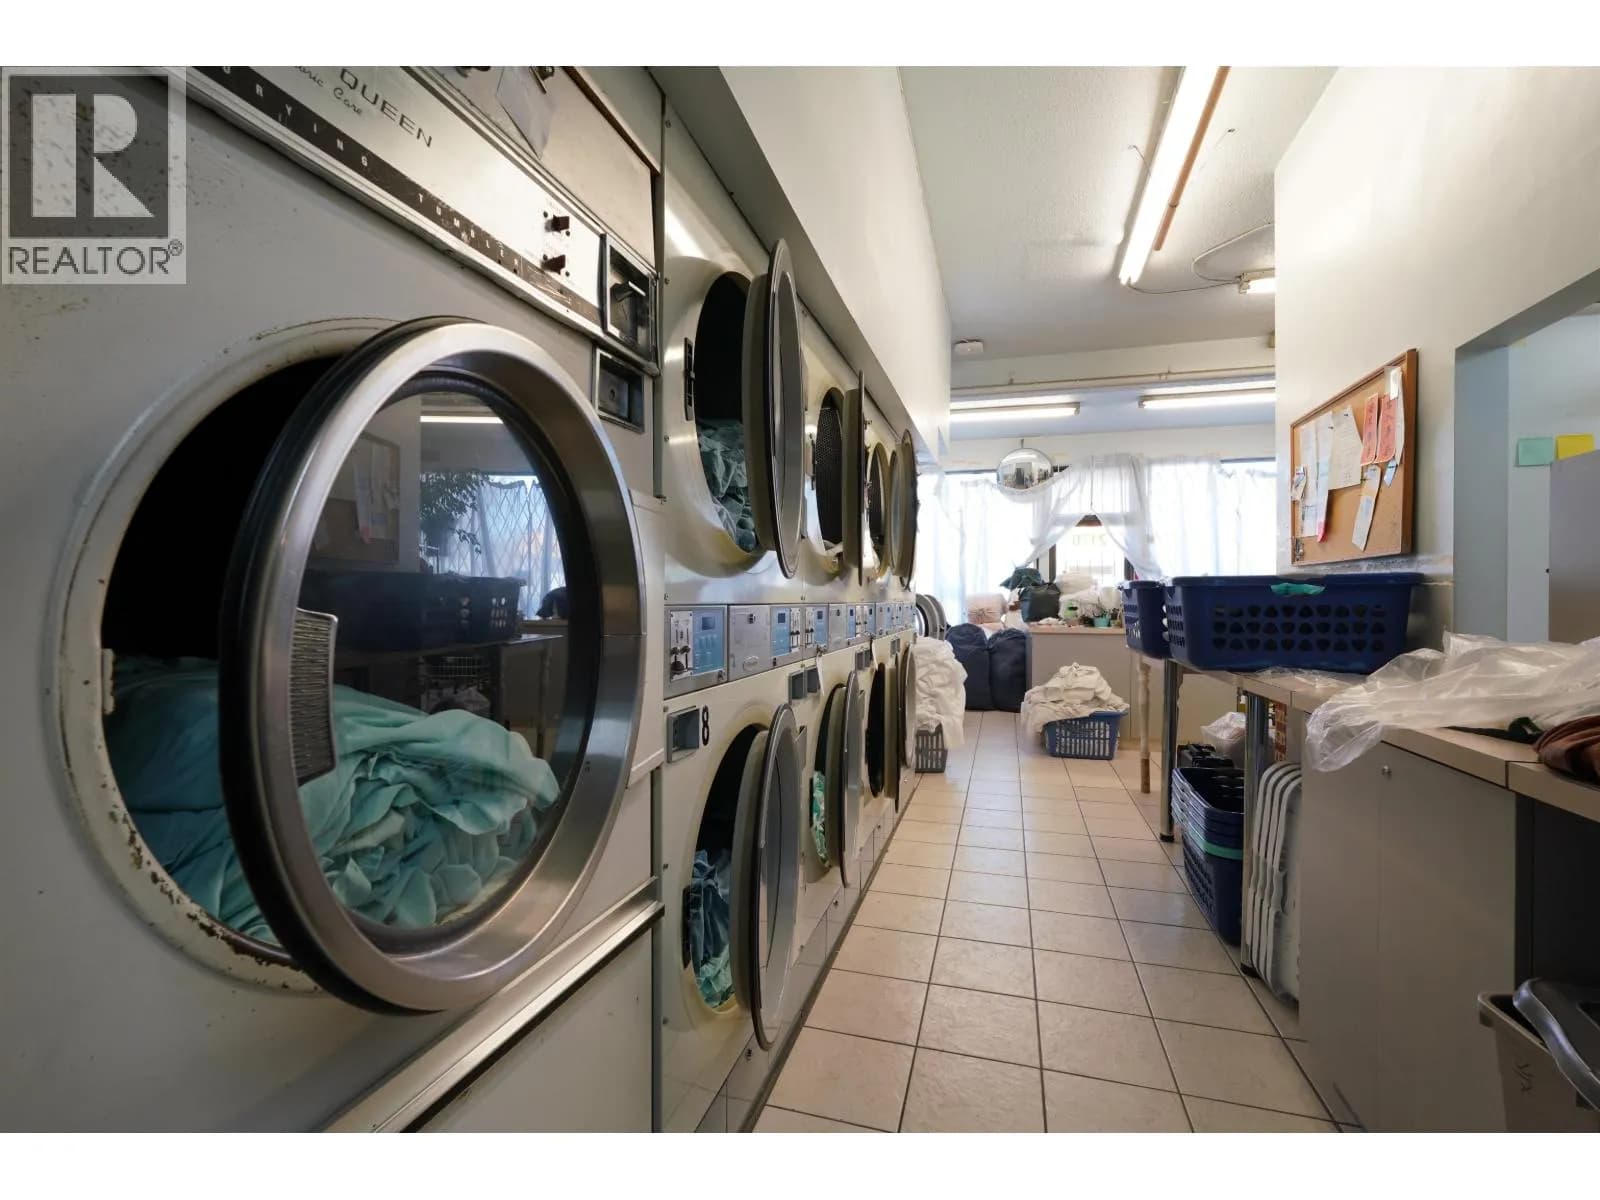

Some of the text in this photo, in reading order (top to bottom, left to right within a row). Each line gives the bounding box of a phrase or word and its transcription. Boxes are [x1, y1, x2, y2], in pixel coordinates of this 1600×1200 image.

[333, 87, 363, 116] Care
[340, 67, 433, 148] QUEEN
[701, 704, 710, 746] 8
